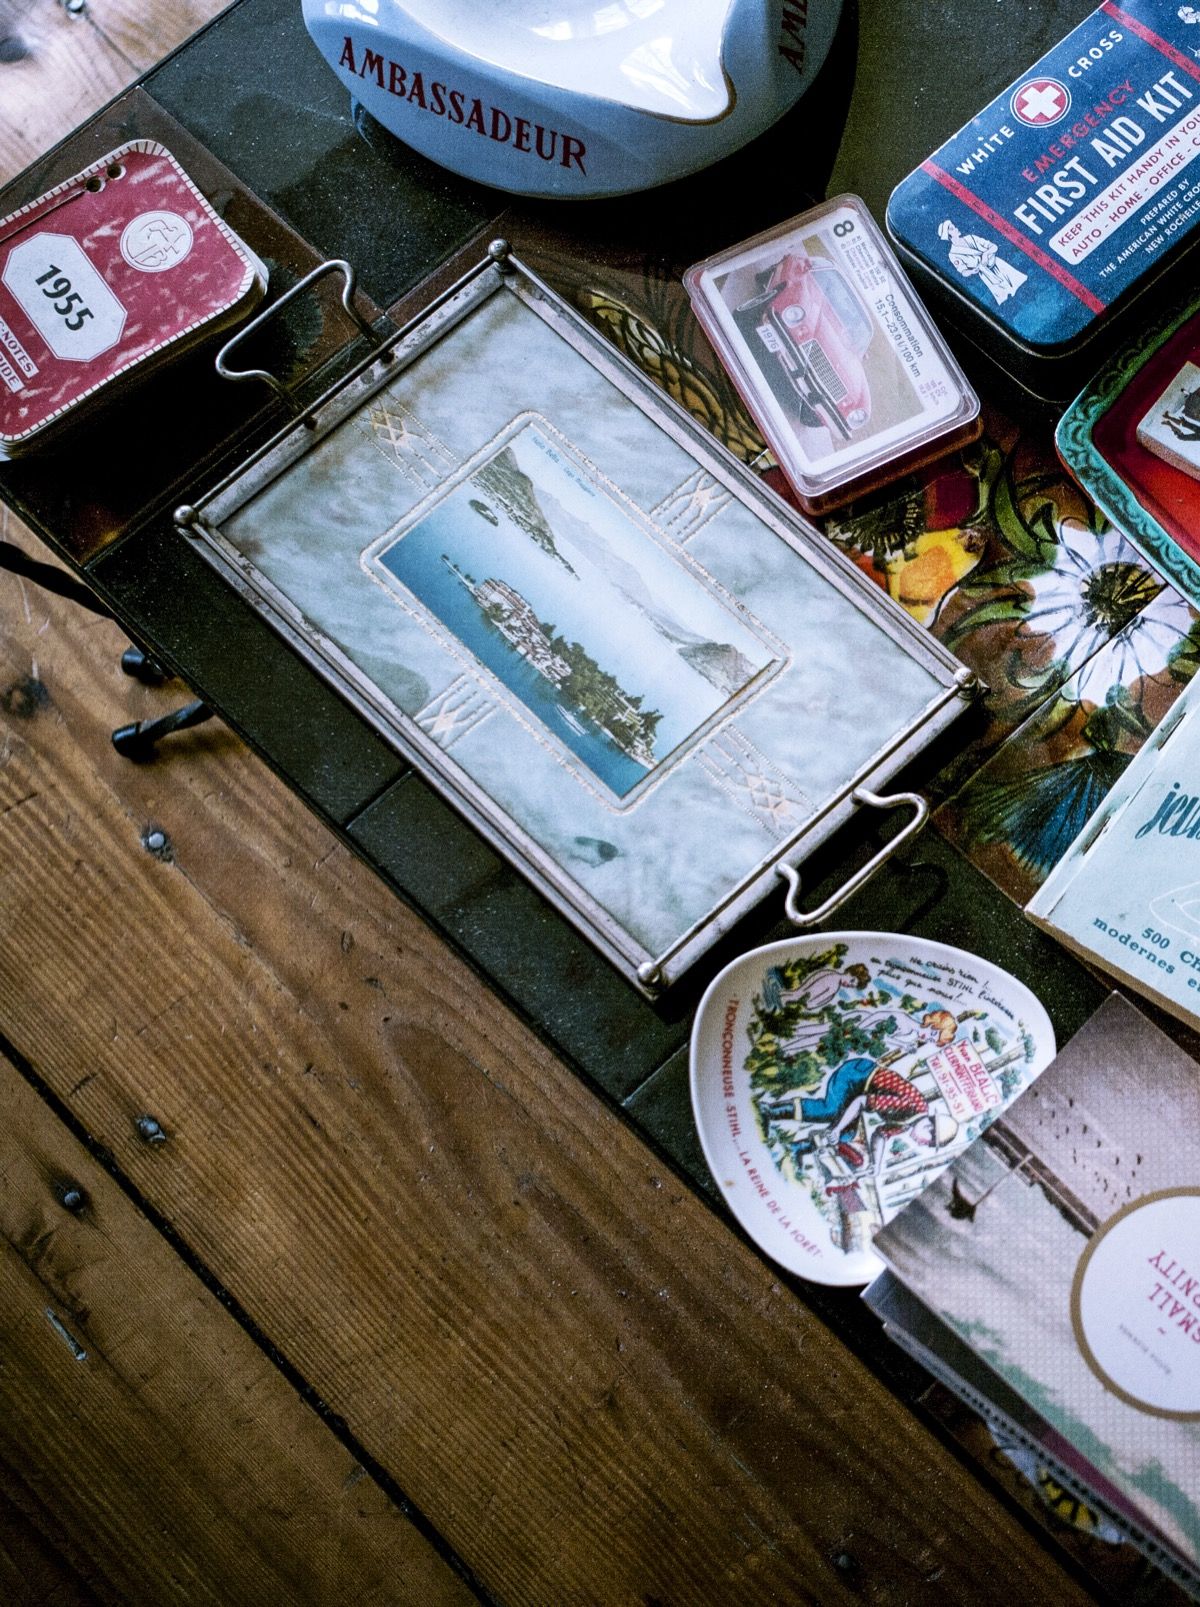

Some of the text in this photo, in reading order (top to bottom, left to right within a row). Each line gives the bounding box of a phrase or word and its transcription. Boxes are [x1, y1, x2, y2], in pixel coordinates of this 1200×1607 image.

[1068, 30, 1123, 79] CROSS
[339, 36, 589, 176] AMBASSADEUR
[1022, 80, 1136, 183] EMERGENCY
[1014, 71, 1193, 235] FIRST AID KIT
[1058, 223, 1083, 246] KEEP
[1084, 200, 1108, 224] THIS
[1109, 183, 1126, 202] KIT
[1127, 148, 1165, 185] HANDY
[1165, 136, 1180, 150] IN
[1072, 228, 1102, 257] AUTO
[1109, 191, 1143, 222] HOME
[1149, 152, 1186, 186] OFFICE
[1140, 178, 1190, 225] PREPARED BY
[834, 220, 854, 237] 8
[1099, 262, 1117, 278] THE
[1116, 225, 1158, 264] AMERICAN
[1157, 202, 1183, 226] WHITE
[1145, 234, 1165, 254] NEW
[35, 264, 94, 331] 1955
[761, 326, 779, 350] 1976
[885, 294, 923, 358] Consommation
[910, 363, 921, 378] km
[1092, 916, 1176, 975] modernes
[1141, 926, 1170, 950] 500
[947, 978, 973, 994] STIHL
[959, 968, 979, 984] rien
[968, 1061, 992, 1093] BEAL
[721, 1000, 741, 1098] TRONÇONNEUSE
[739, 1151, 750, 1168] LA
[748, 1167, 770, 1199] REINE
[767, 1200, 781, 1217] DE
[779, 1216, 791, 1230] LA
